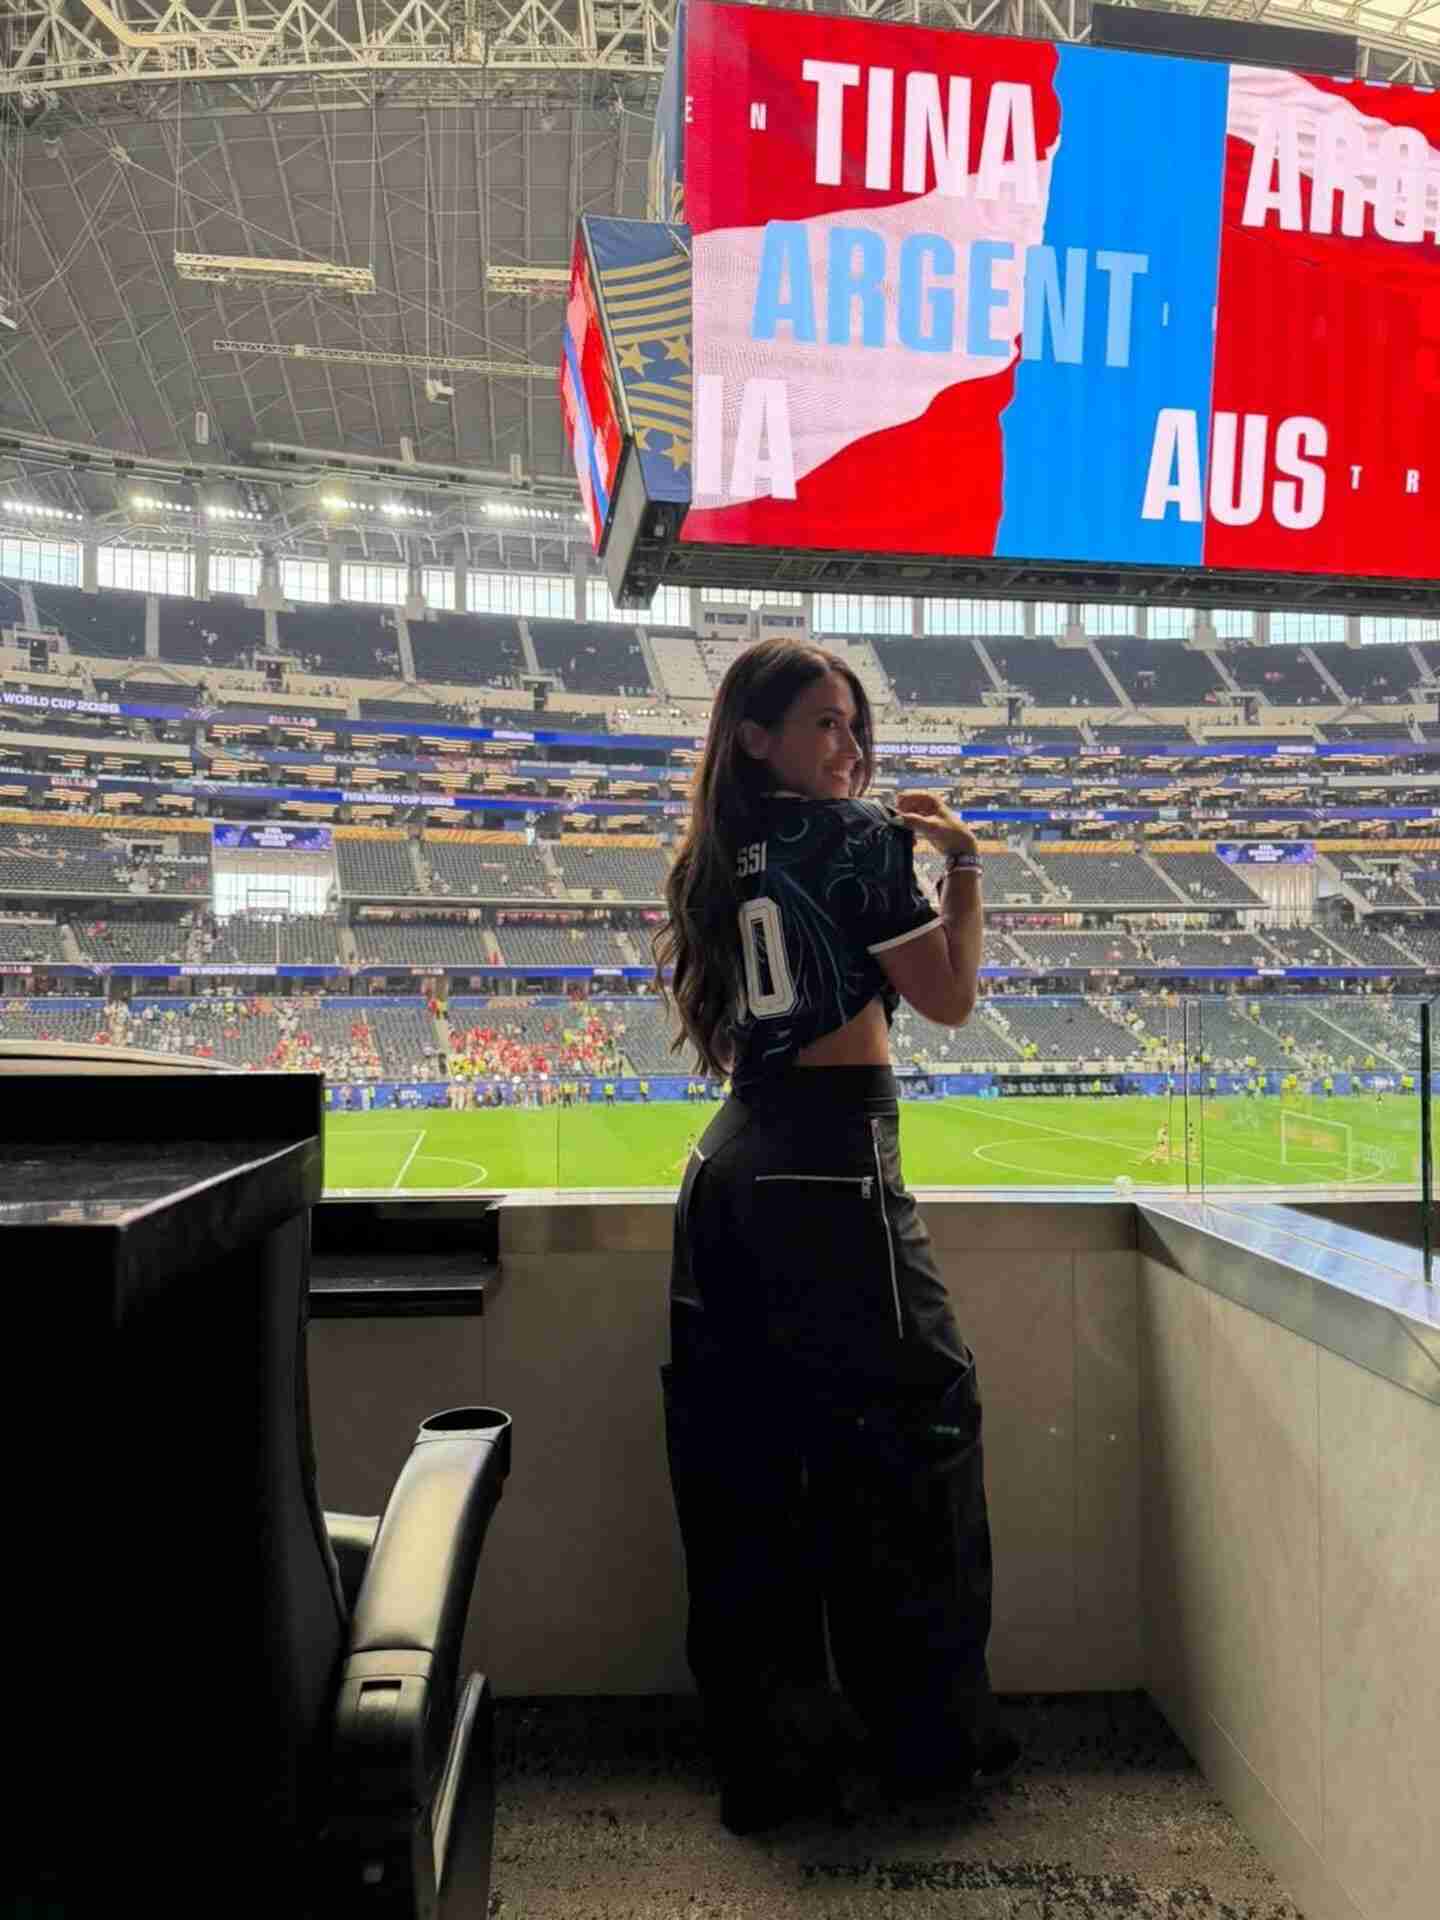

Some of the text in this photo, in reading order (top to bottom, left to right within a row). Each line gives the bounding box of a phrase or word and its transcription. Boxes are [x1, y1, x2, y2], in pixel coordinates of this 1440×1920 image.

[750, 102, 767, 131] N
[802, 59, 1041, 205] TINA
[751, 219, 1149, 368] ARGENT
[694, 374, 798, 502] IA
[1142, 408, 1420, 530] AUS T R
[3, 693, 48, 706] WORLD
[51, 697, 76, 709] CUP
[736, 841, 768, 877] SSI
[736, 895, 800, 1021] 0
